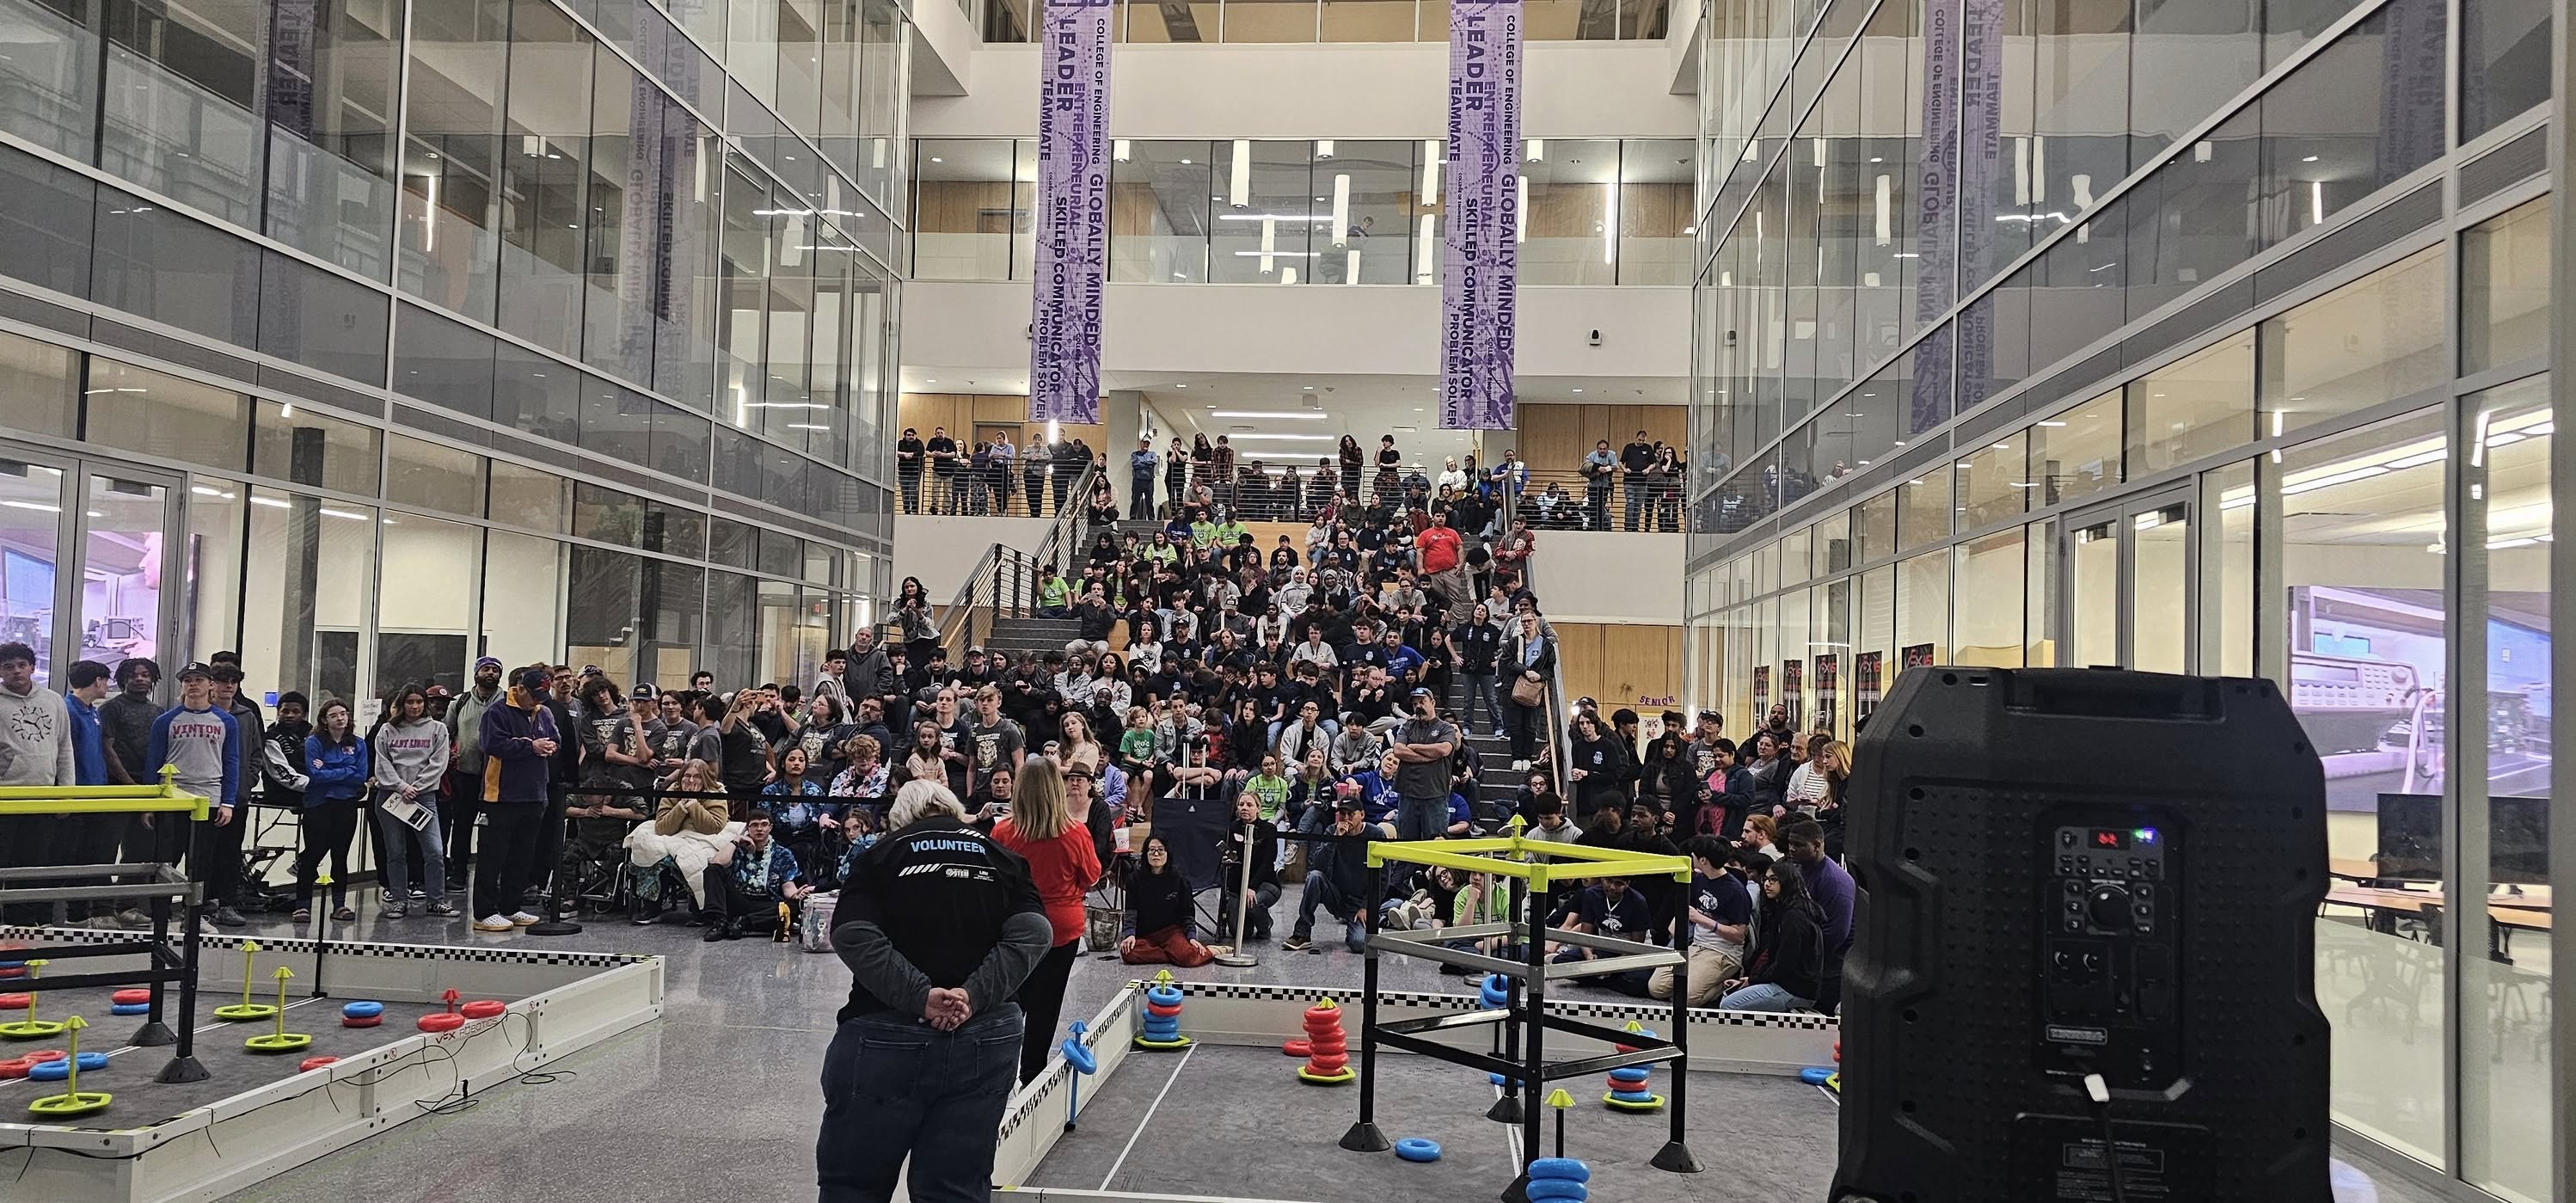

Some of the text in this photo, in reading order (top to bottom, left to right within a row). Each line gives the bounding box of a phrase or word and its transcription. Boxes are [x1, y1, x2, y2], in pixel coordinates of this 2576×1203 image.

[1057, 18, 1076, 112] LEADER
[1092, 18, 1105, 165] COLLEGE OF ENGINEERING
[1466, 15, 1486, 111] LEADER
[1503, 15, 1516, 165] COLLEGE OF ENGINEERING
[1040, 78, 1054, 161] TEAMMATE
[1070, 83, 1086, 230] ENTREPRENEURIAL
[1450, 77, 1463, 162] TEAMMATE
[1481, 81, 1496, 231] ENTREPRENEURIAL
[1049, 196, 1067, 394] SKILLED COMMUNICATOR
[1084, 173, 1104, 347] GLOBALLY MINDED
[1461, 198, 1478, 400] SKILLED COMMUNICATOR
[1497, 174, 1516, 351] GLOBALLY MINDED
[1035, 309, 1049, 420] PROBLEM SOLVER
[1446, 313, 1460, 427] PROBLEM SOLVER
[172, 724, 222, 735] VINTON
[1639, 695, 1676, 707] SENIOR
[910, 839, 986, 856] VOLUNTEER
[435, 1017, 498, 1045] VEX ROBOTICS
